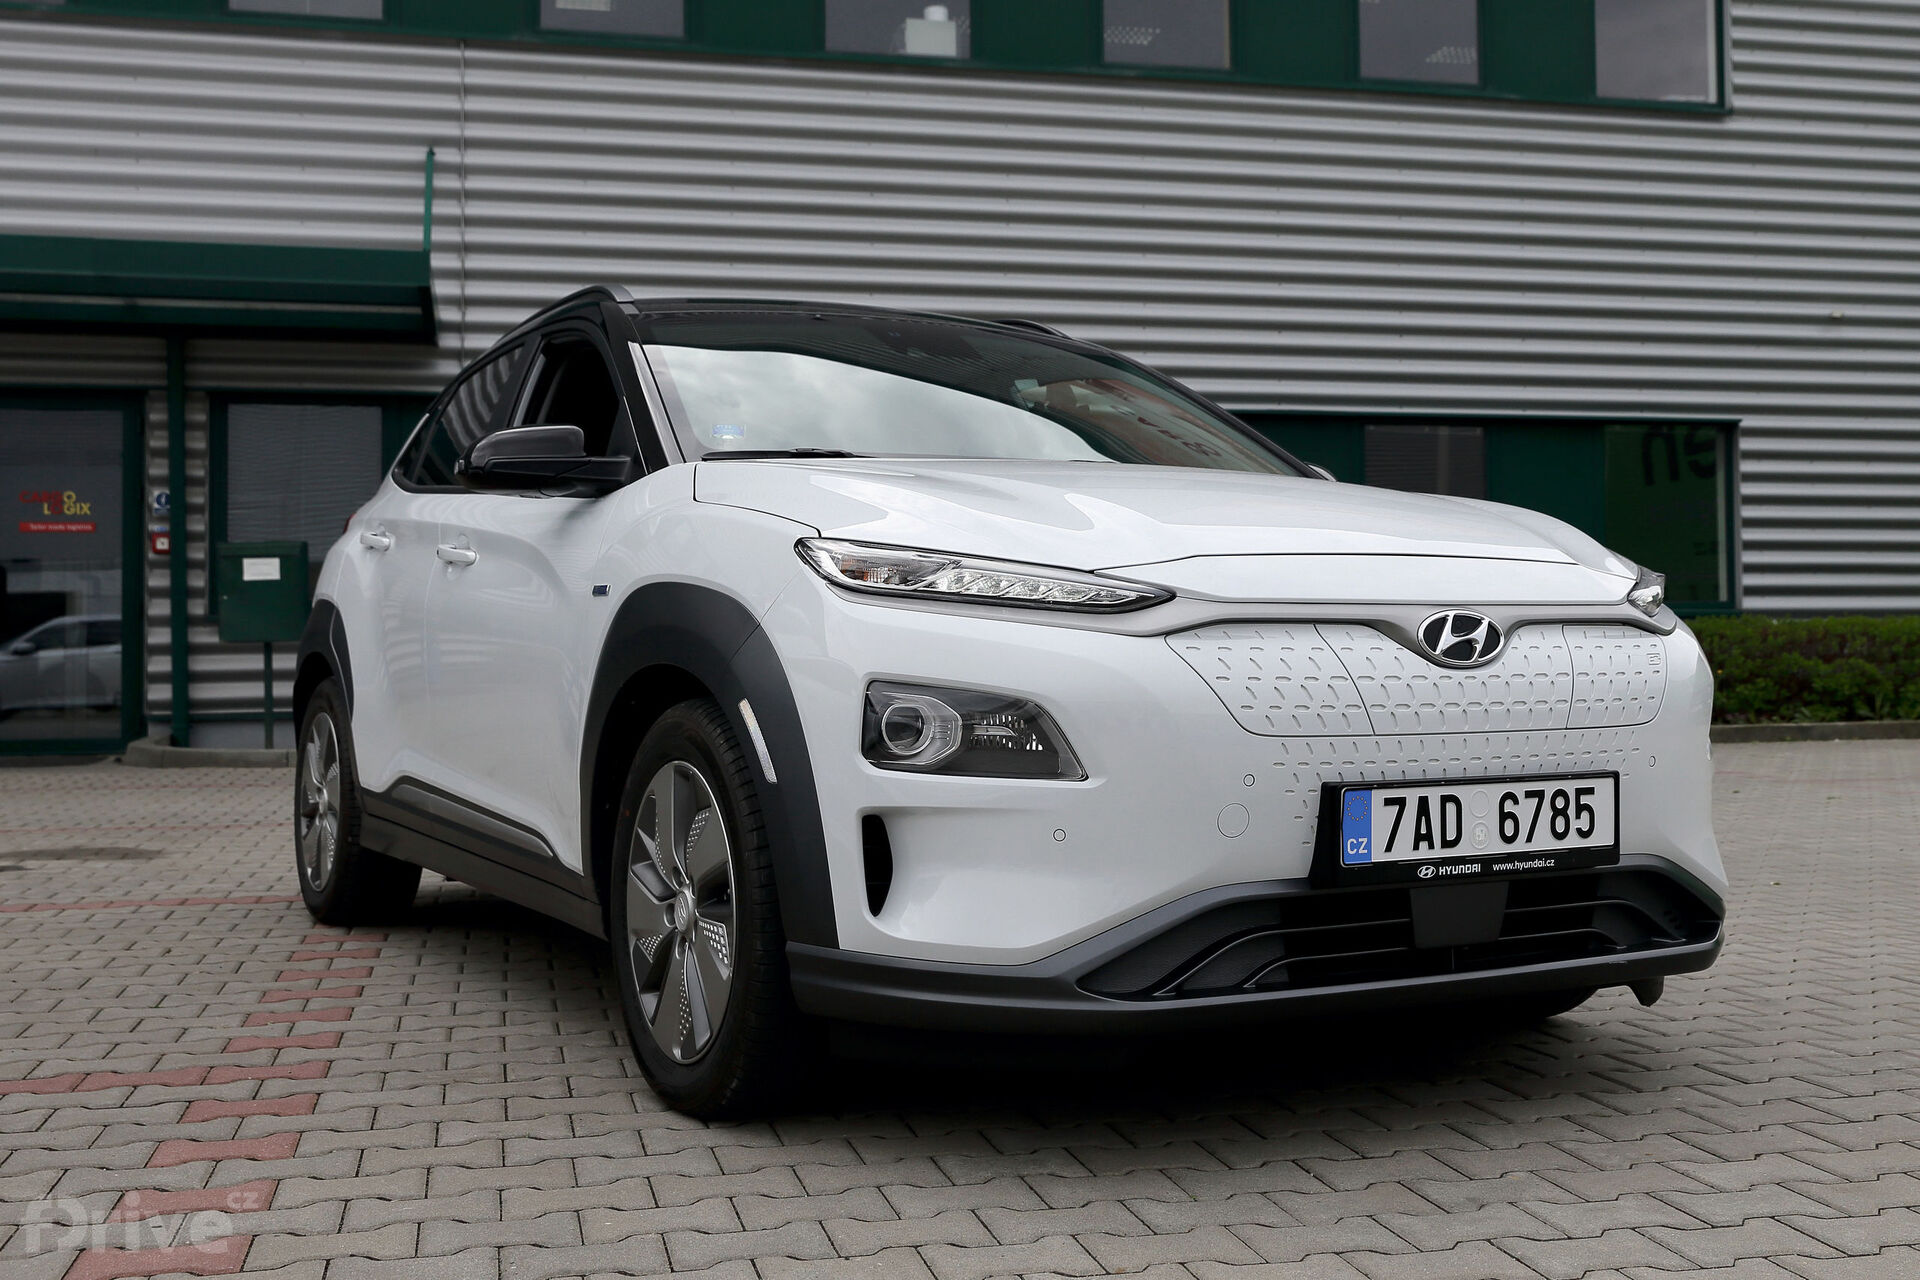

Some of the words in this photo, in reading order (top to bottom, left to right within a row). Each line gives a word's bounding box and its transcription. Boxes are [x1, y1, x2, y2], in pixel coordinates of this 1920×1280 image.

[19, 490, 77, 503] CARGO
[43, 502, 91, 515] LOGIX
[1347, 838, 1368, 855] CZ
[1383, 793, 1463, 853] 7AD
[1498, 786, 1596, 845] 6785
[1438, 863, 1482, 876] HYUNDAI
[1492, 858, 1556, 872] www.hyundai.cz
